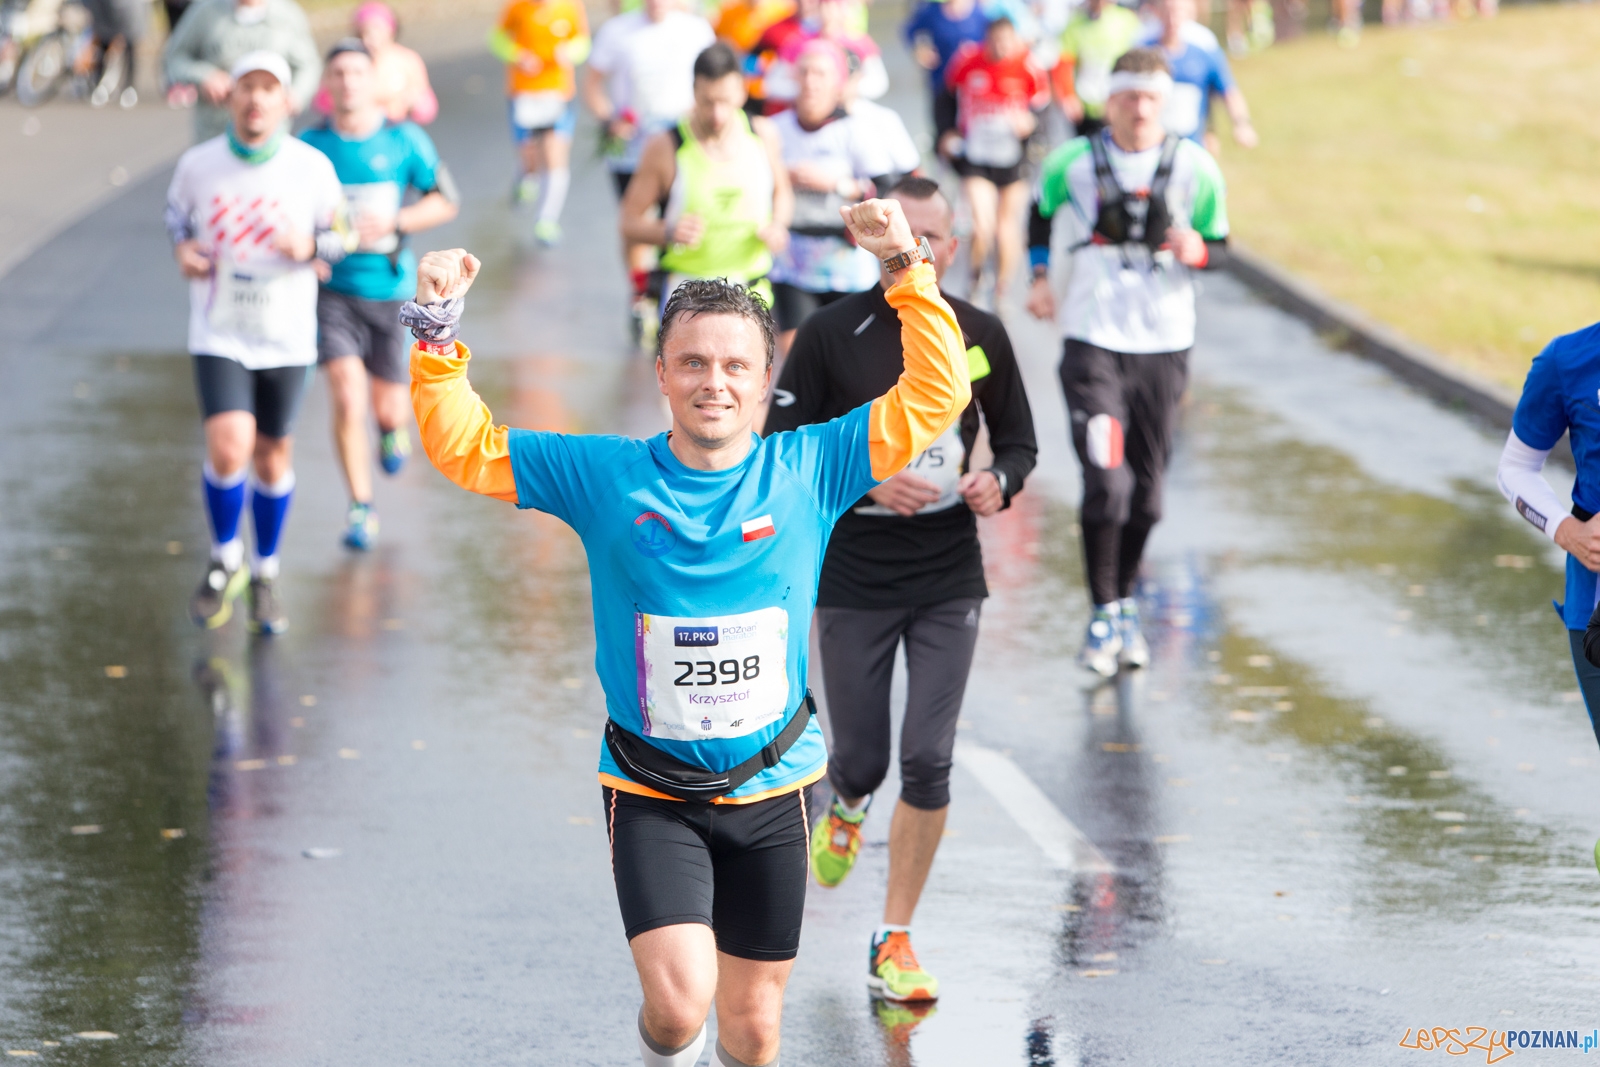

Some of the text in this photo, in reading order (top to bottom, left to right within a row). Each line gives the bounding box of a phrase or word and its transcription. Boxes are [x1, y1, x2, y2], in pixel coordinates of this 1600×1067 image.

[723, 631, 757, 641] maraton
[674, 655, 760, 686] 2398
[689, 689, 750, 705] Krzysztof
